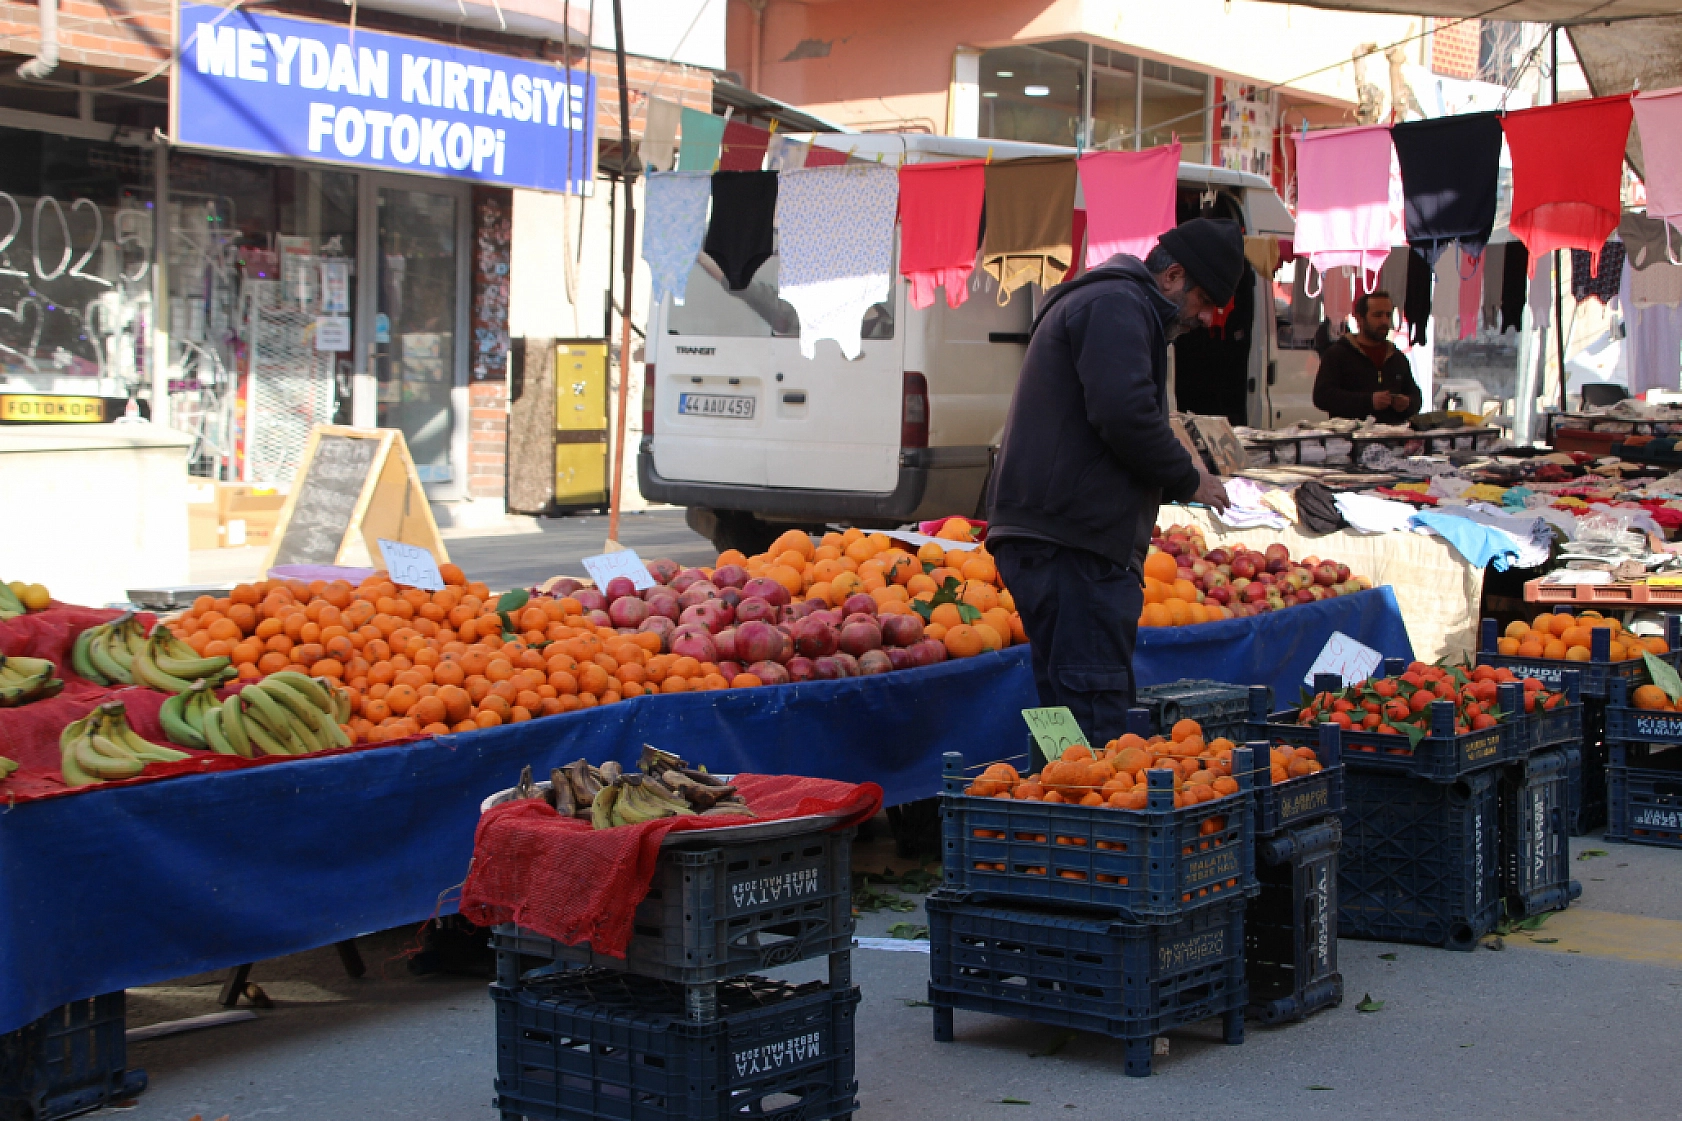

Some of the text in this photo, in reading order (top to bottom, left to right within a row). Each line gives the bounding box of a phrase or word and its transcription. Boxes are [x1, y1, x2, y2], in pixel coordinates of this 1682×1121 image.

[196, 23, 390, 99] MEYDAN
[675, 345, 717, 356] TRANSIT
[686, 396, 700, 412] 44
[728, 400, 752, 416] 459
[732, 878, 819, 908] MALATYA
[736, 1041, 820, 1078] MALATYA
